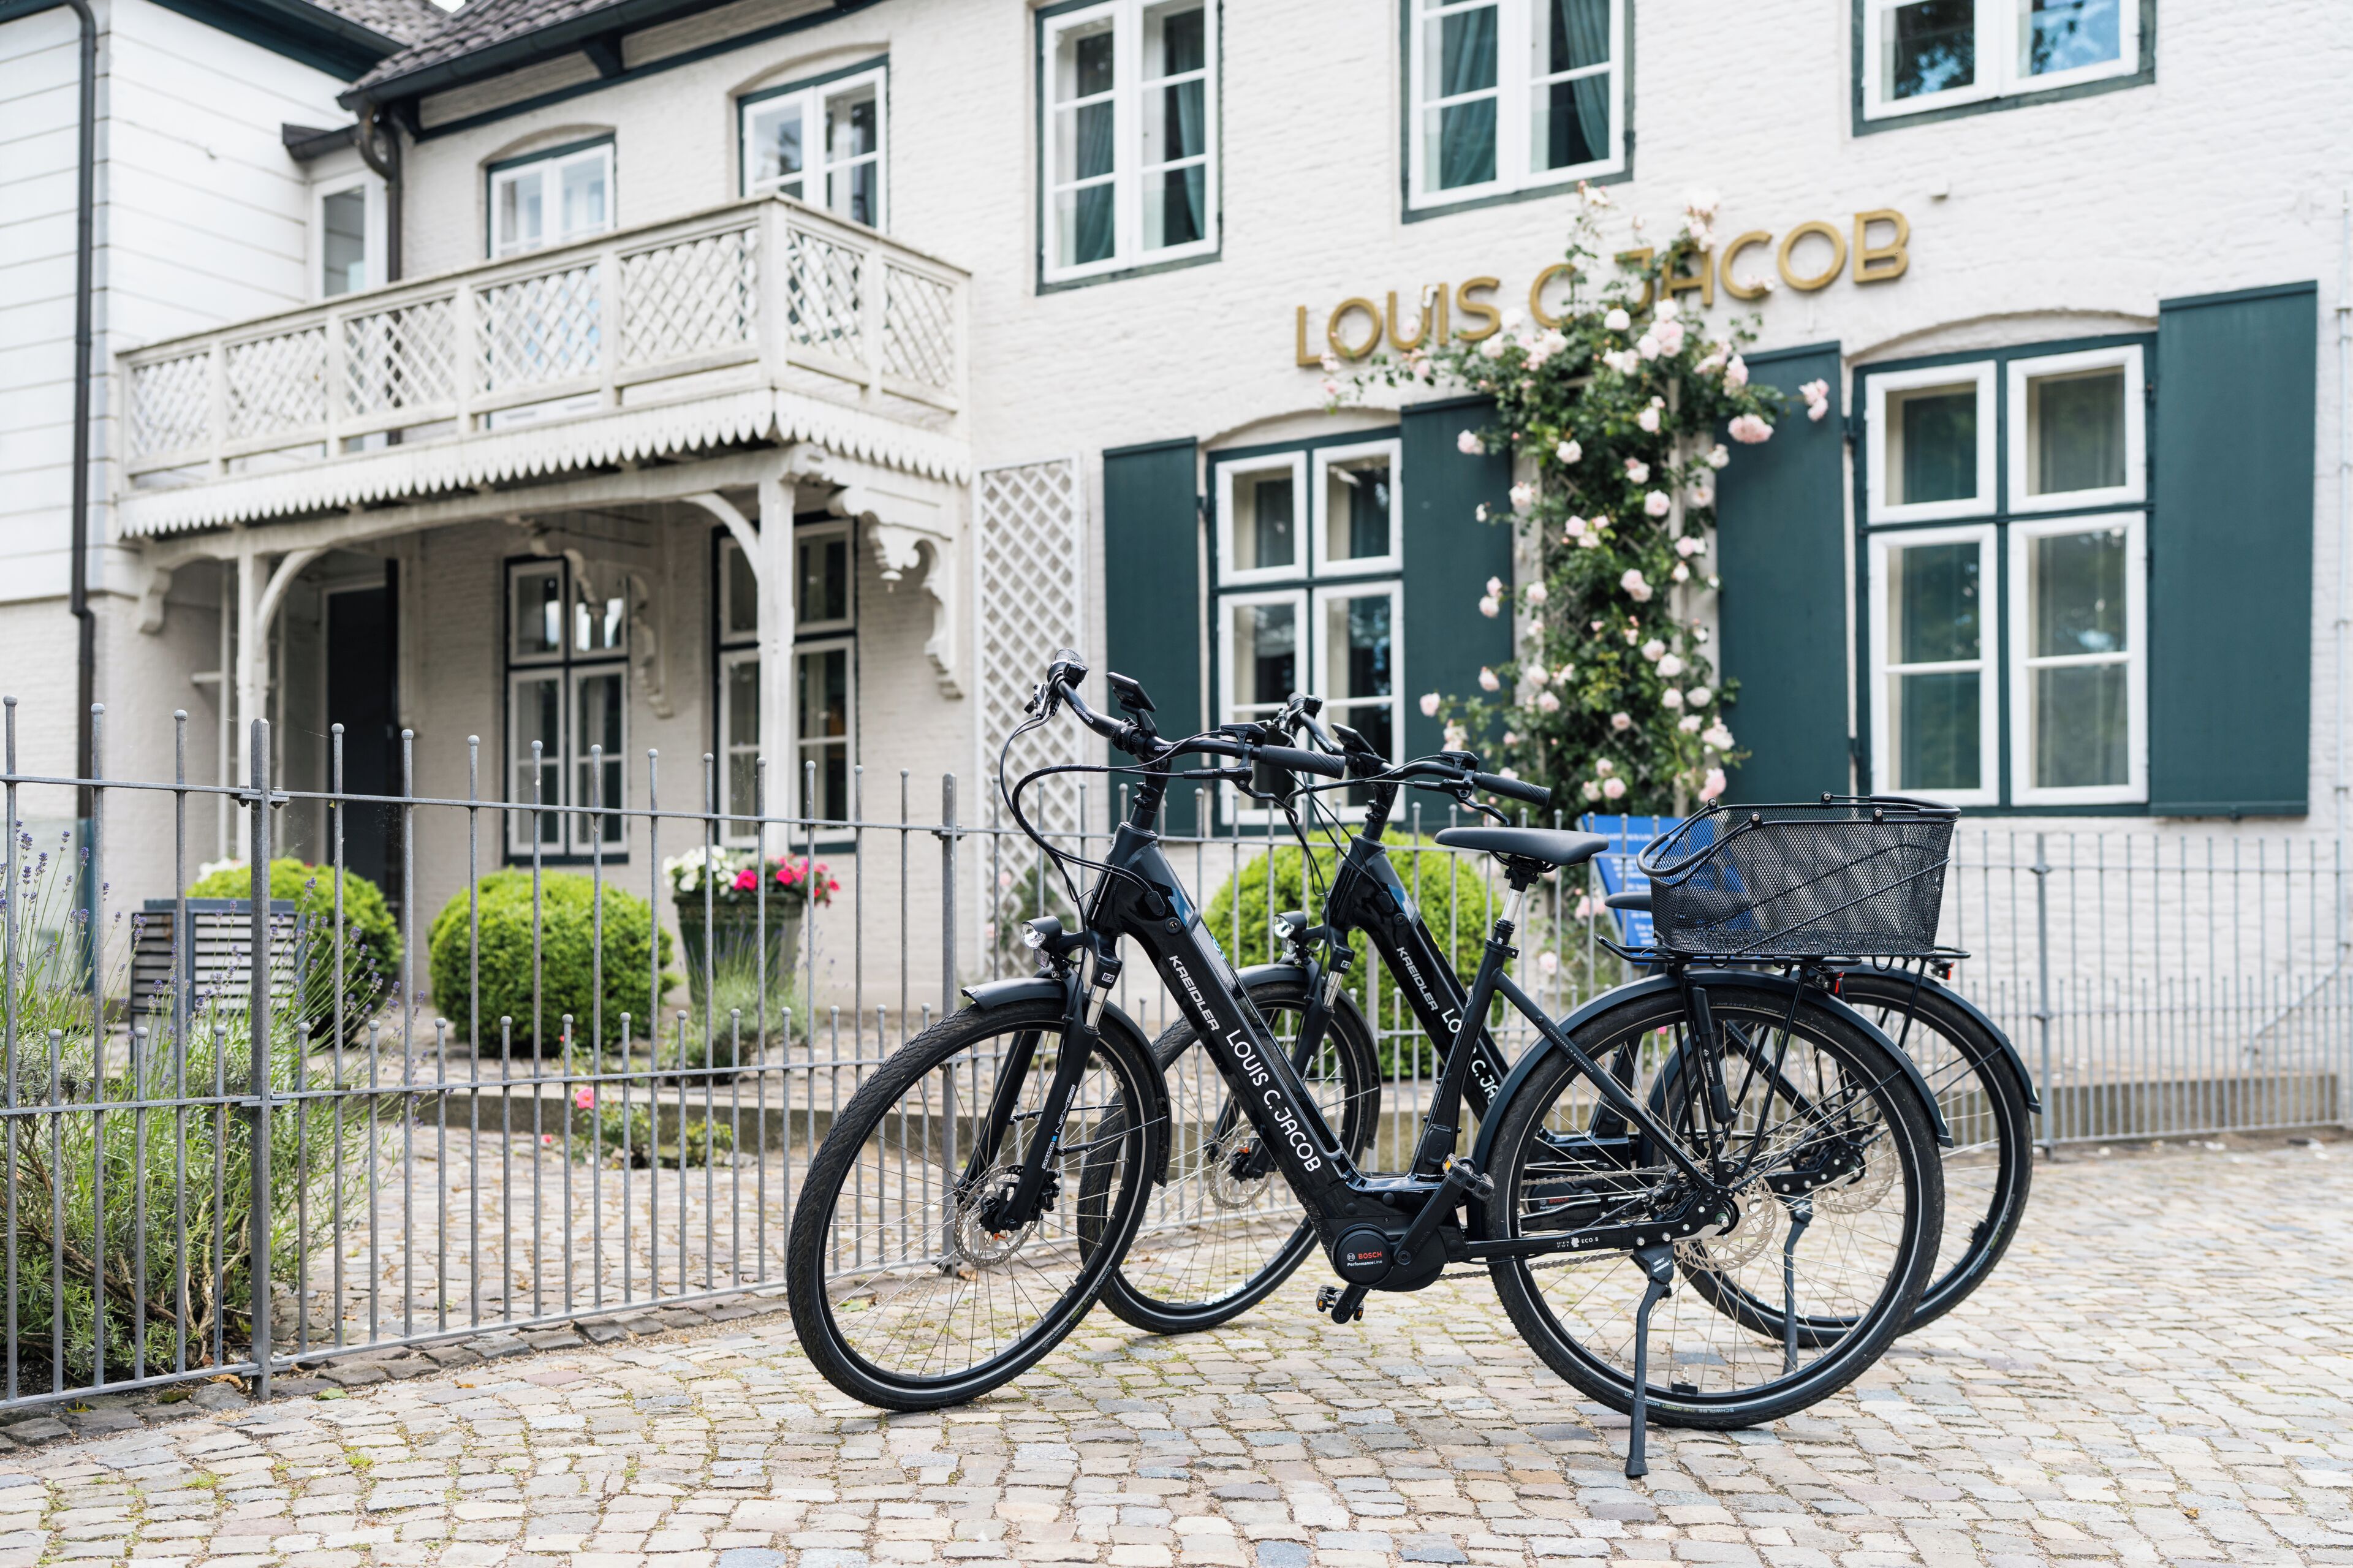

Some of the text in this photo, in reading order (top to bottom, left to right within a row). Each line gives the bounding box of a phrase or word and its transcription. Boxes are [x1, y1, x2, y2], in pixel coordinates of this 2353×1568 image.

[1297, 276, 1501, 366] LOUIS
[1615, 209, 1909, 317] JACOB
[1169, 955, 1220, 1031] KREIDLER
[1397, 947, 1439, 1011] KREIDLER
[1471, 1059, 1486, 1077] C.
[1548, 1028, 1569, 1048] ENGINEERED
[1574, 1053, 1593, 1073] OLDENBURG
[1226, 1029, 1269, 1086] LOUIS
[1264, 1089, 1281, 1110] C.
[1274, 1107, 1322, 1172] JACOB
[1091, 1265, 1113, 1295] SCHWALBE
